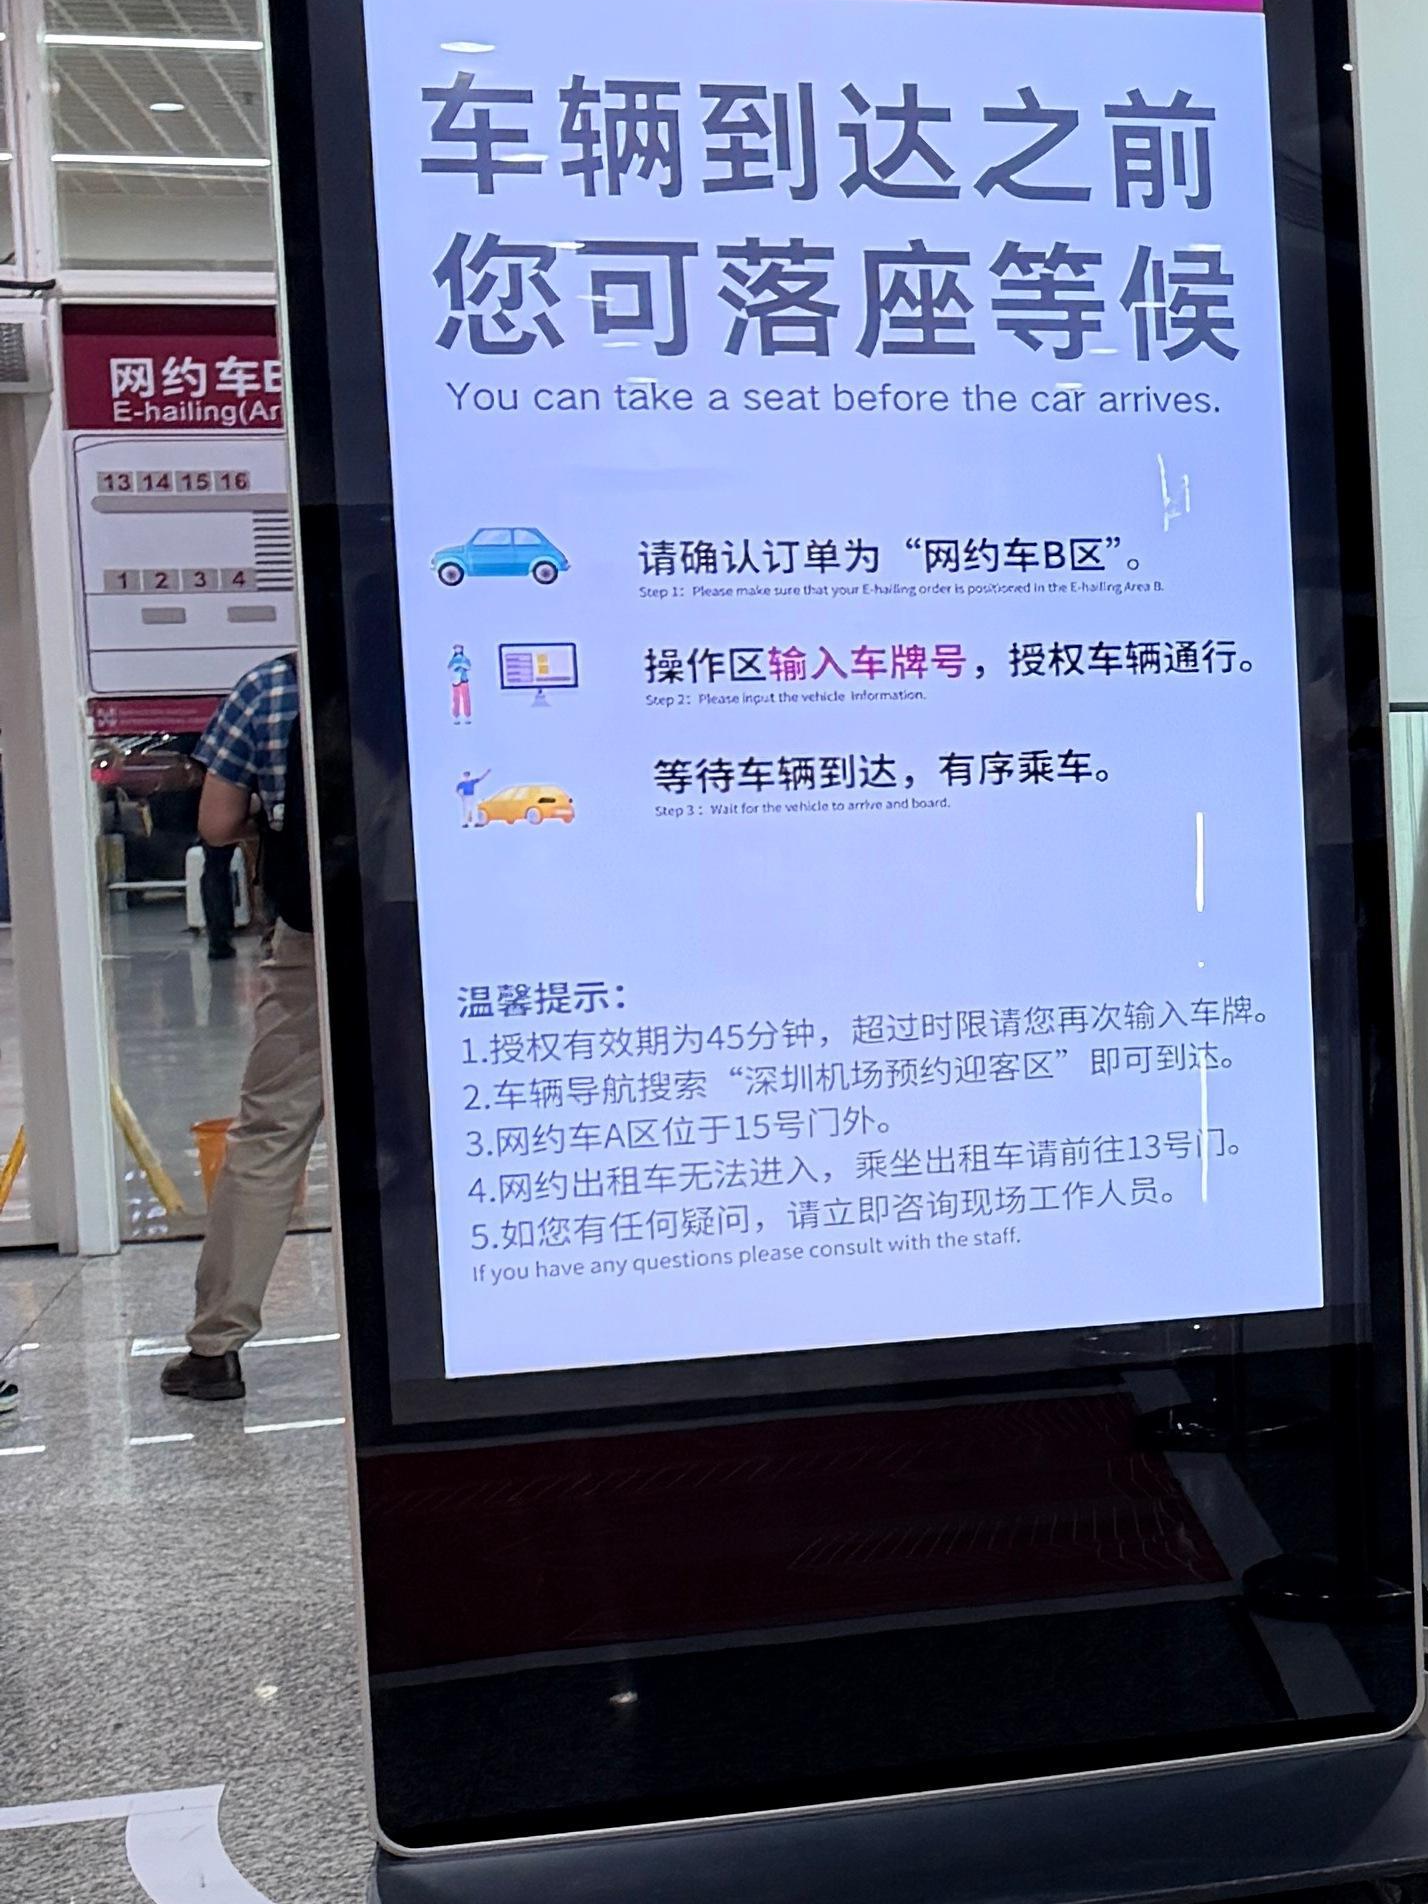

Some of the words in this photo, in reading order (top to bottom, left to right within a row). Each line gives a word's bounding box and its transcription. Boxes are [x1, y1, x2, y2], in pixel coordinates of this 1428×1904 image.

[418, 71, 1218, 212] 车辆到达之前
[431, 231, 1242, 363] 您可落座等候
[446, 382, 519, 411] You
[534, 388, 600, 411] can
[614, 382, 693, 411] take
[708, 388, 729, 411] a
[744, 385, 820, 411] seat
[833, 383, 949, 412] before
[962, 383, 1017, 412] the
[1031, 389, 1085, 412] car
[1099, 385, 1220, 413] arrives.
[103, 474, 131, 491] 13
[143, 473, 170, 490] 14
[181, 473, 210, 490] 15
[220, 473, 248, 490] 16
[118, 572, 127, 589] 1
[155, 572, 169, 588] 2
[194, 571, 207, 587] 3
[232, 571, 245, 587] 4
[639, 585, 670, 600] Step
[693, 585, 733, 597] Please
[736, 584, 771, 596] make
[831, 585, 858, 598] your
[919, 581, 951, 594] order
[1048, 581, 1068, 593] the
[699, 692, 740, 704] Please
[779, 690, 799, 703] the
[655, 804, 684, 818] Step
[710, 802, 738, 815] Wait
[741, 801, 759, 814] for
[762, 800, 782, 813] the
[832, 799, 845, 811] to
[886, 797, 909, 810] and
[472, 1264, 485, 1282] If
[491, 1265, 529, 1286] you
[536, 1260, 585, 1278] have
[590, 1257, 628, 1277] any
[633, 1249, 733, 1275] questions
[739, 1241, 804, 1267] please
[810, 1236, 883, 1259] consult
[889, 1232, 930, 1252] with
[936, 1230, 968, 1249] the
[974, 1225, 1021, 1247] staff.
